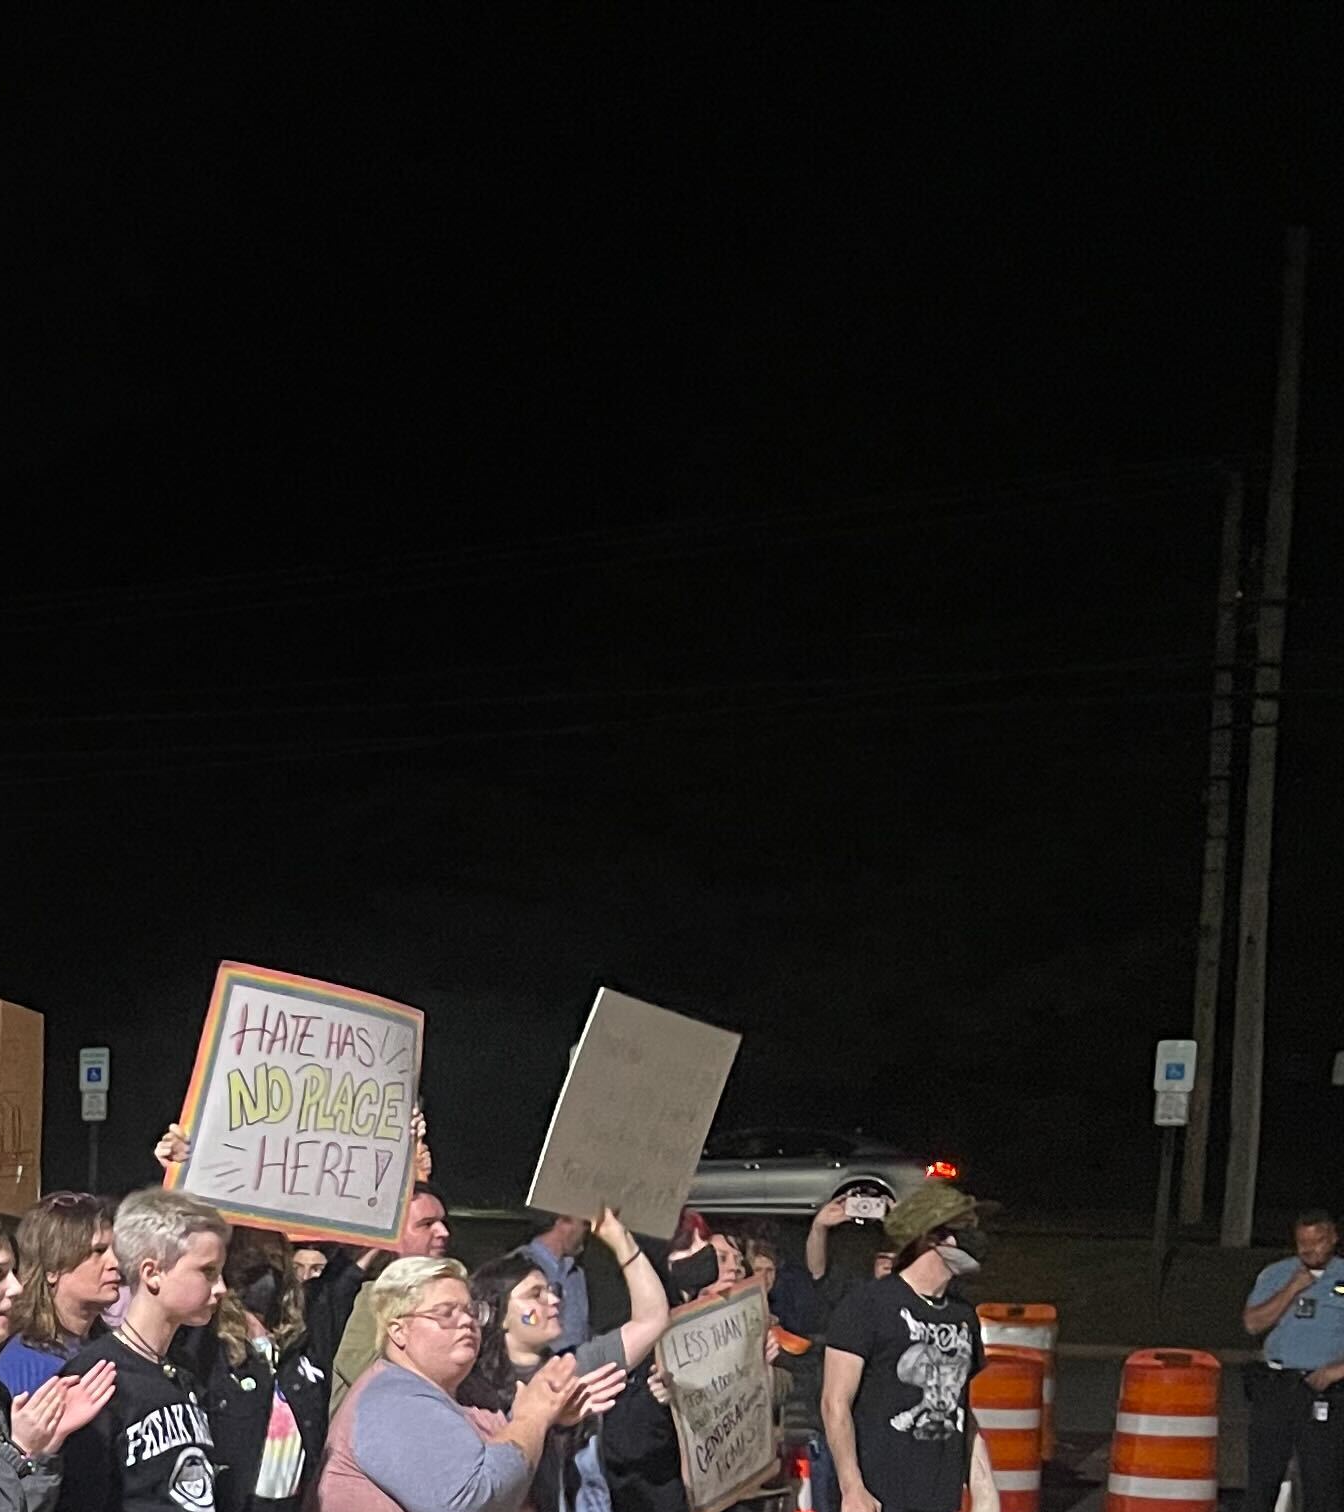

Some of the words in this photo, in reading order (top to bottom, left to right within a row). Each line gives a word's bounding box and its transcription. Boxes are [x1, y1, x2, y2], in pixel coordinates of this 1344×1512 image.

[230, 1003, 323, 1057] HATE
[325, 1021, 375, 1067] HAS
[227, 1062, 293, 1131] NO
[295, 1063, 405, 1142] PLACE
[254, 1135, 393, 1208] HERE!
[672, 1330, 710, 1368] LESS
[711, 1317, 743, 1353] THAN
